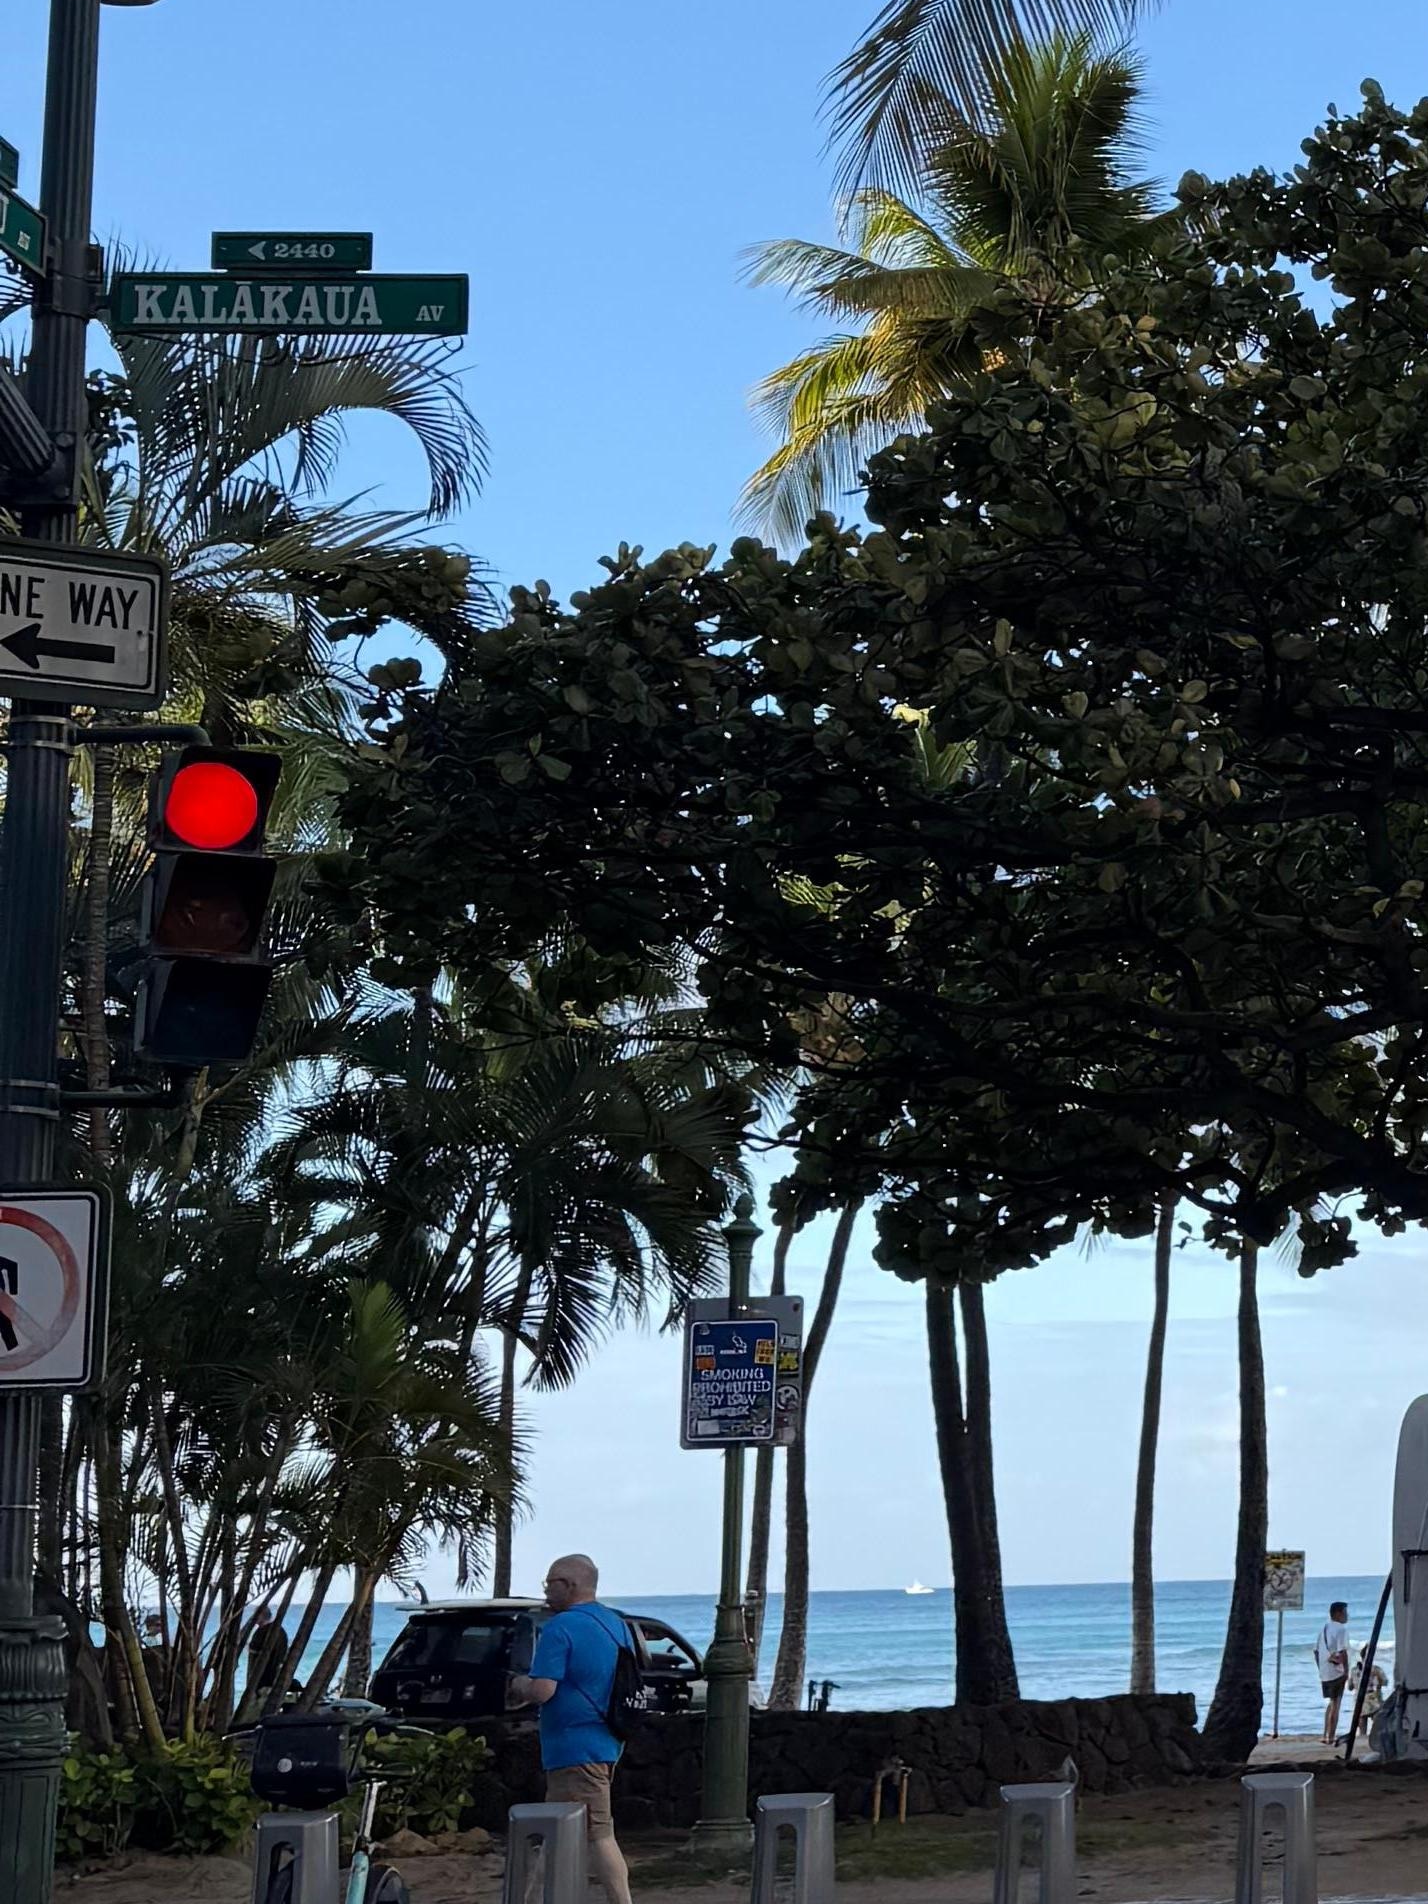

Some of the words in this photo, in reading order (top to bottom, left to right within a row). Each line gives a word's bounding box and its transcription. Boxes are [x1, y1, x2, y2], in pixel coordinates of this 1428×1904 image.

[274, 243, 336, 258] 2440
[133, 281, 383, 324] KALĀKAUA
[415, 305, 445, 321] AV
[0, 573, 45, 619] NE
[69, 581, 139, 630] WAY
[700, 1368, 763, 1380] SMOKING
[693, 1381, 771, 1392] PROHIBITED
